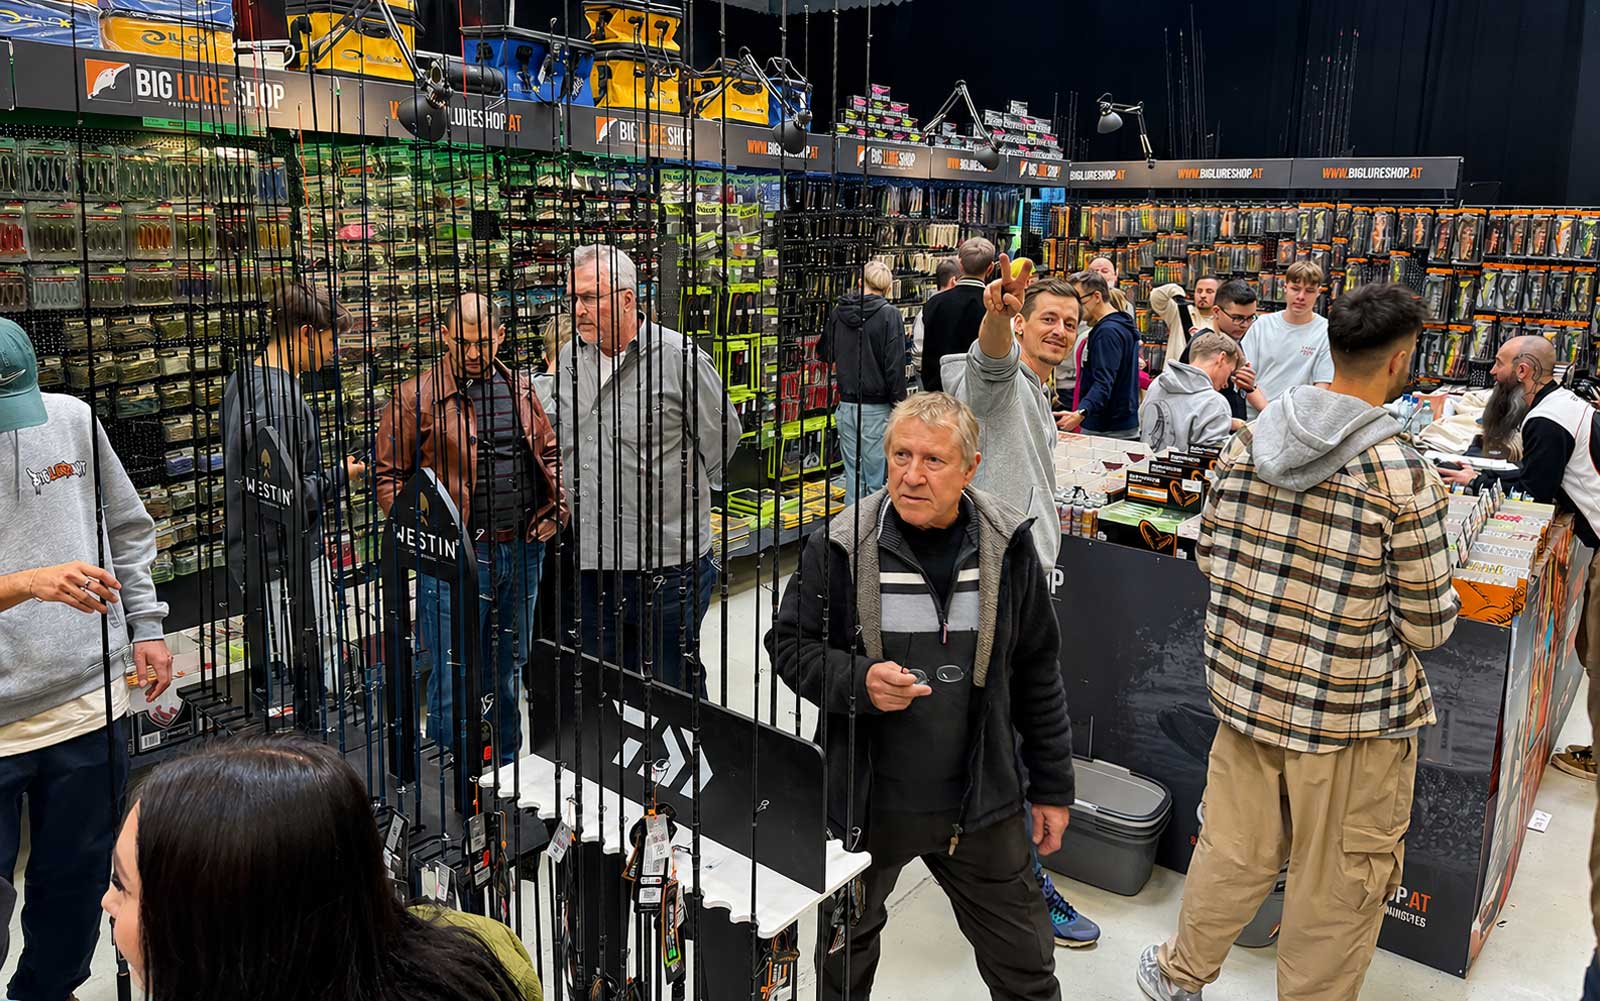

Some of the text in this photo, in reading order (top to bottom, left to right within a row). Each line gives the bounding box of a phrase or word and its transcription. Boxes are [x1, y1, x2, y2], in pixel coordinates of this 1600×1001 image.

[136, 68, 173, 99] BIG
[176, 72, 230, 106] LURE
[233, 79, 285, 110] SHOP
[1177, 167, 1264, 179] WWW.BIGLURESHOP.AT
[1322, 166, 1423, 179] WWW.BIGLURESHOP.AT
